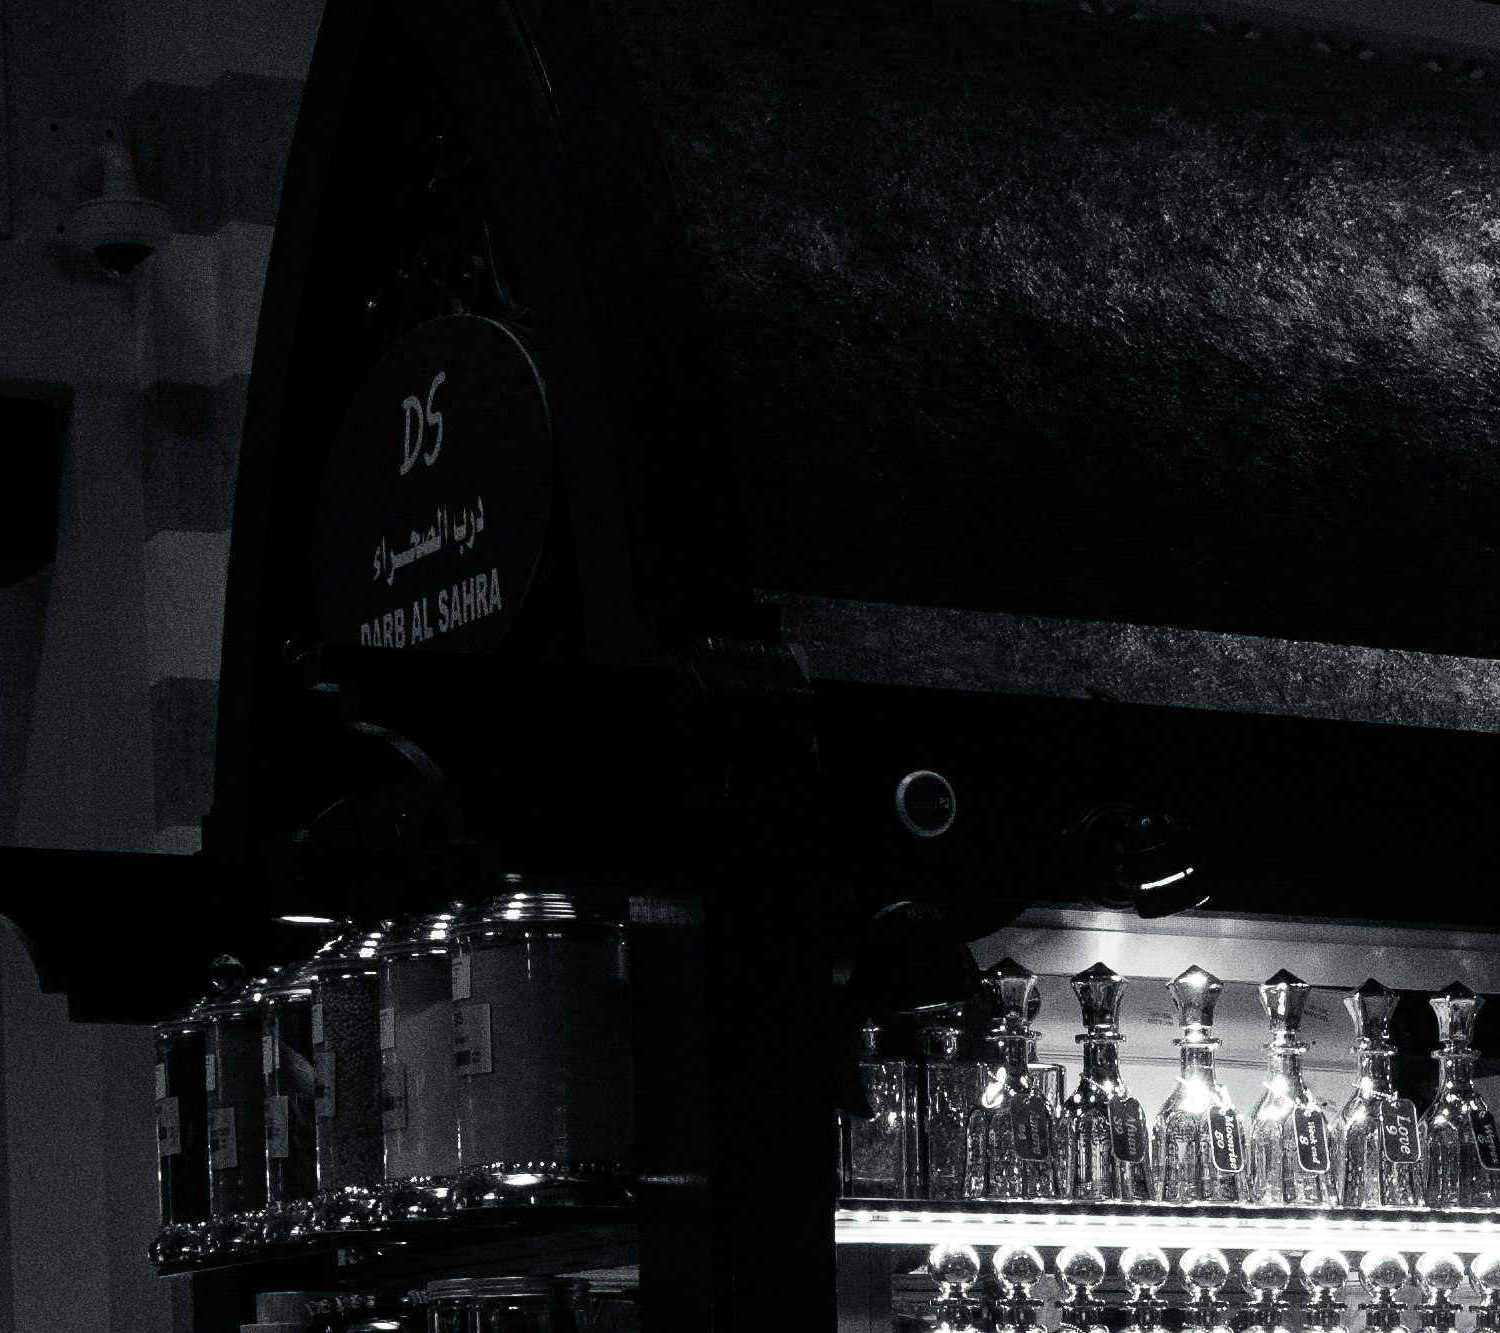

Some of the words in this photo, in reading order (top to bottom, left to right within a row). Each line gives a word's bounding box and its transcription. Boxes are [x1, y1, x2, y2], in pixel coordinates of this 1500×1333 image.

[360, 606, 406, 649] DARB
[410, 598, 434, 646] AL
[437, 567, 503, 634] SAHRA
[1224, 1115, 1237, 1170] Moonrise
[1386, 1125, 1397, 1135] 9
[1396, 1115, 1412, 1155] Love
